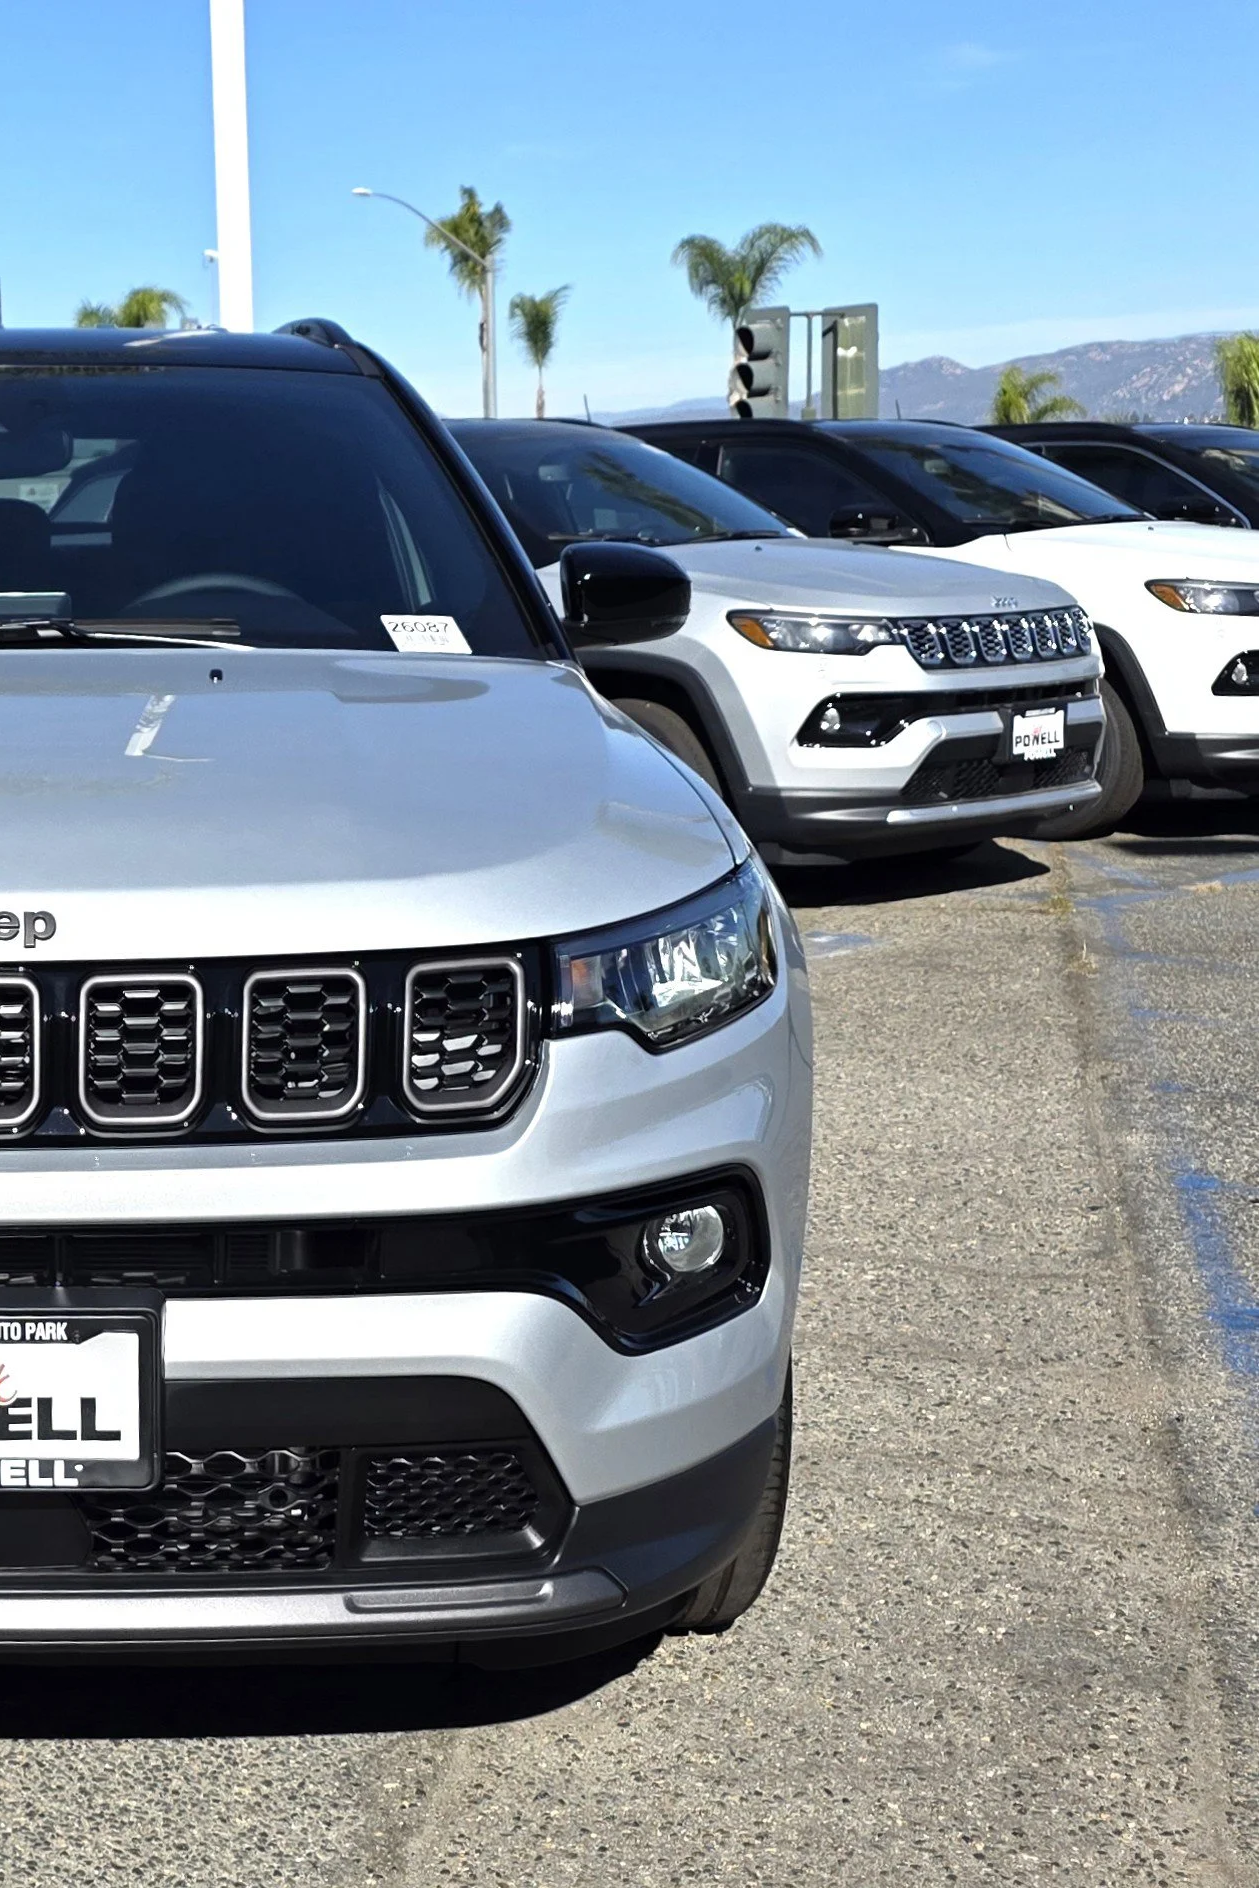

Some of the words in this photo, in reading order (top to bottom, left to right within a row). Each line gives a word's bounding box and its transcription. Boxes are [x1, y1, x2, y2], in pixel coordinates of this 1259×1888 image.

[387, 621, 448, 633] 26087
[1015, 730, 1060, 747] POWELL
[25, 1322, 68, 1341] PARK
